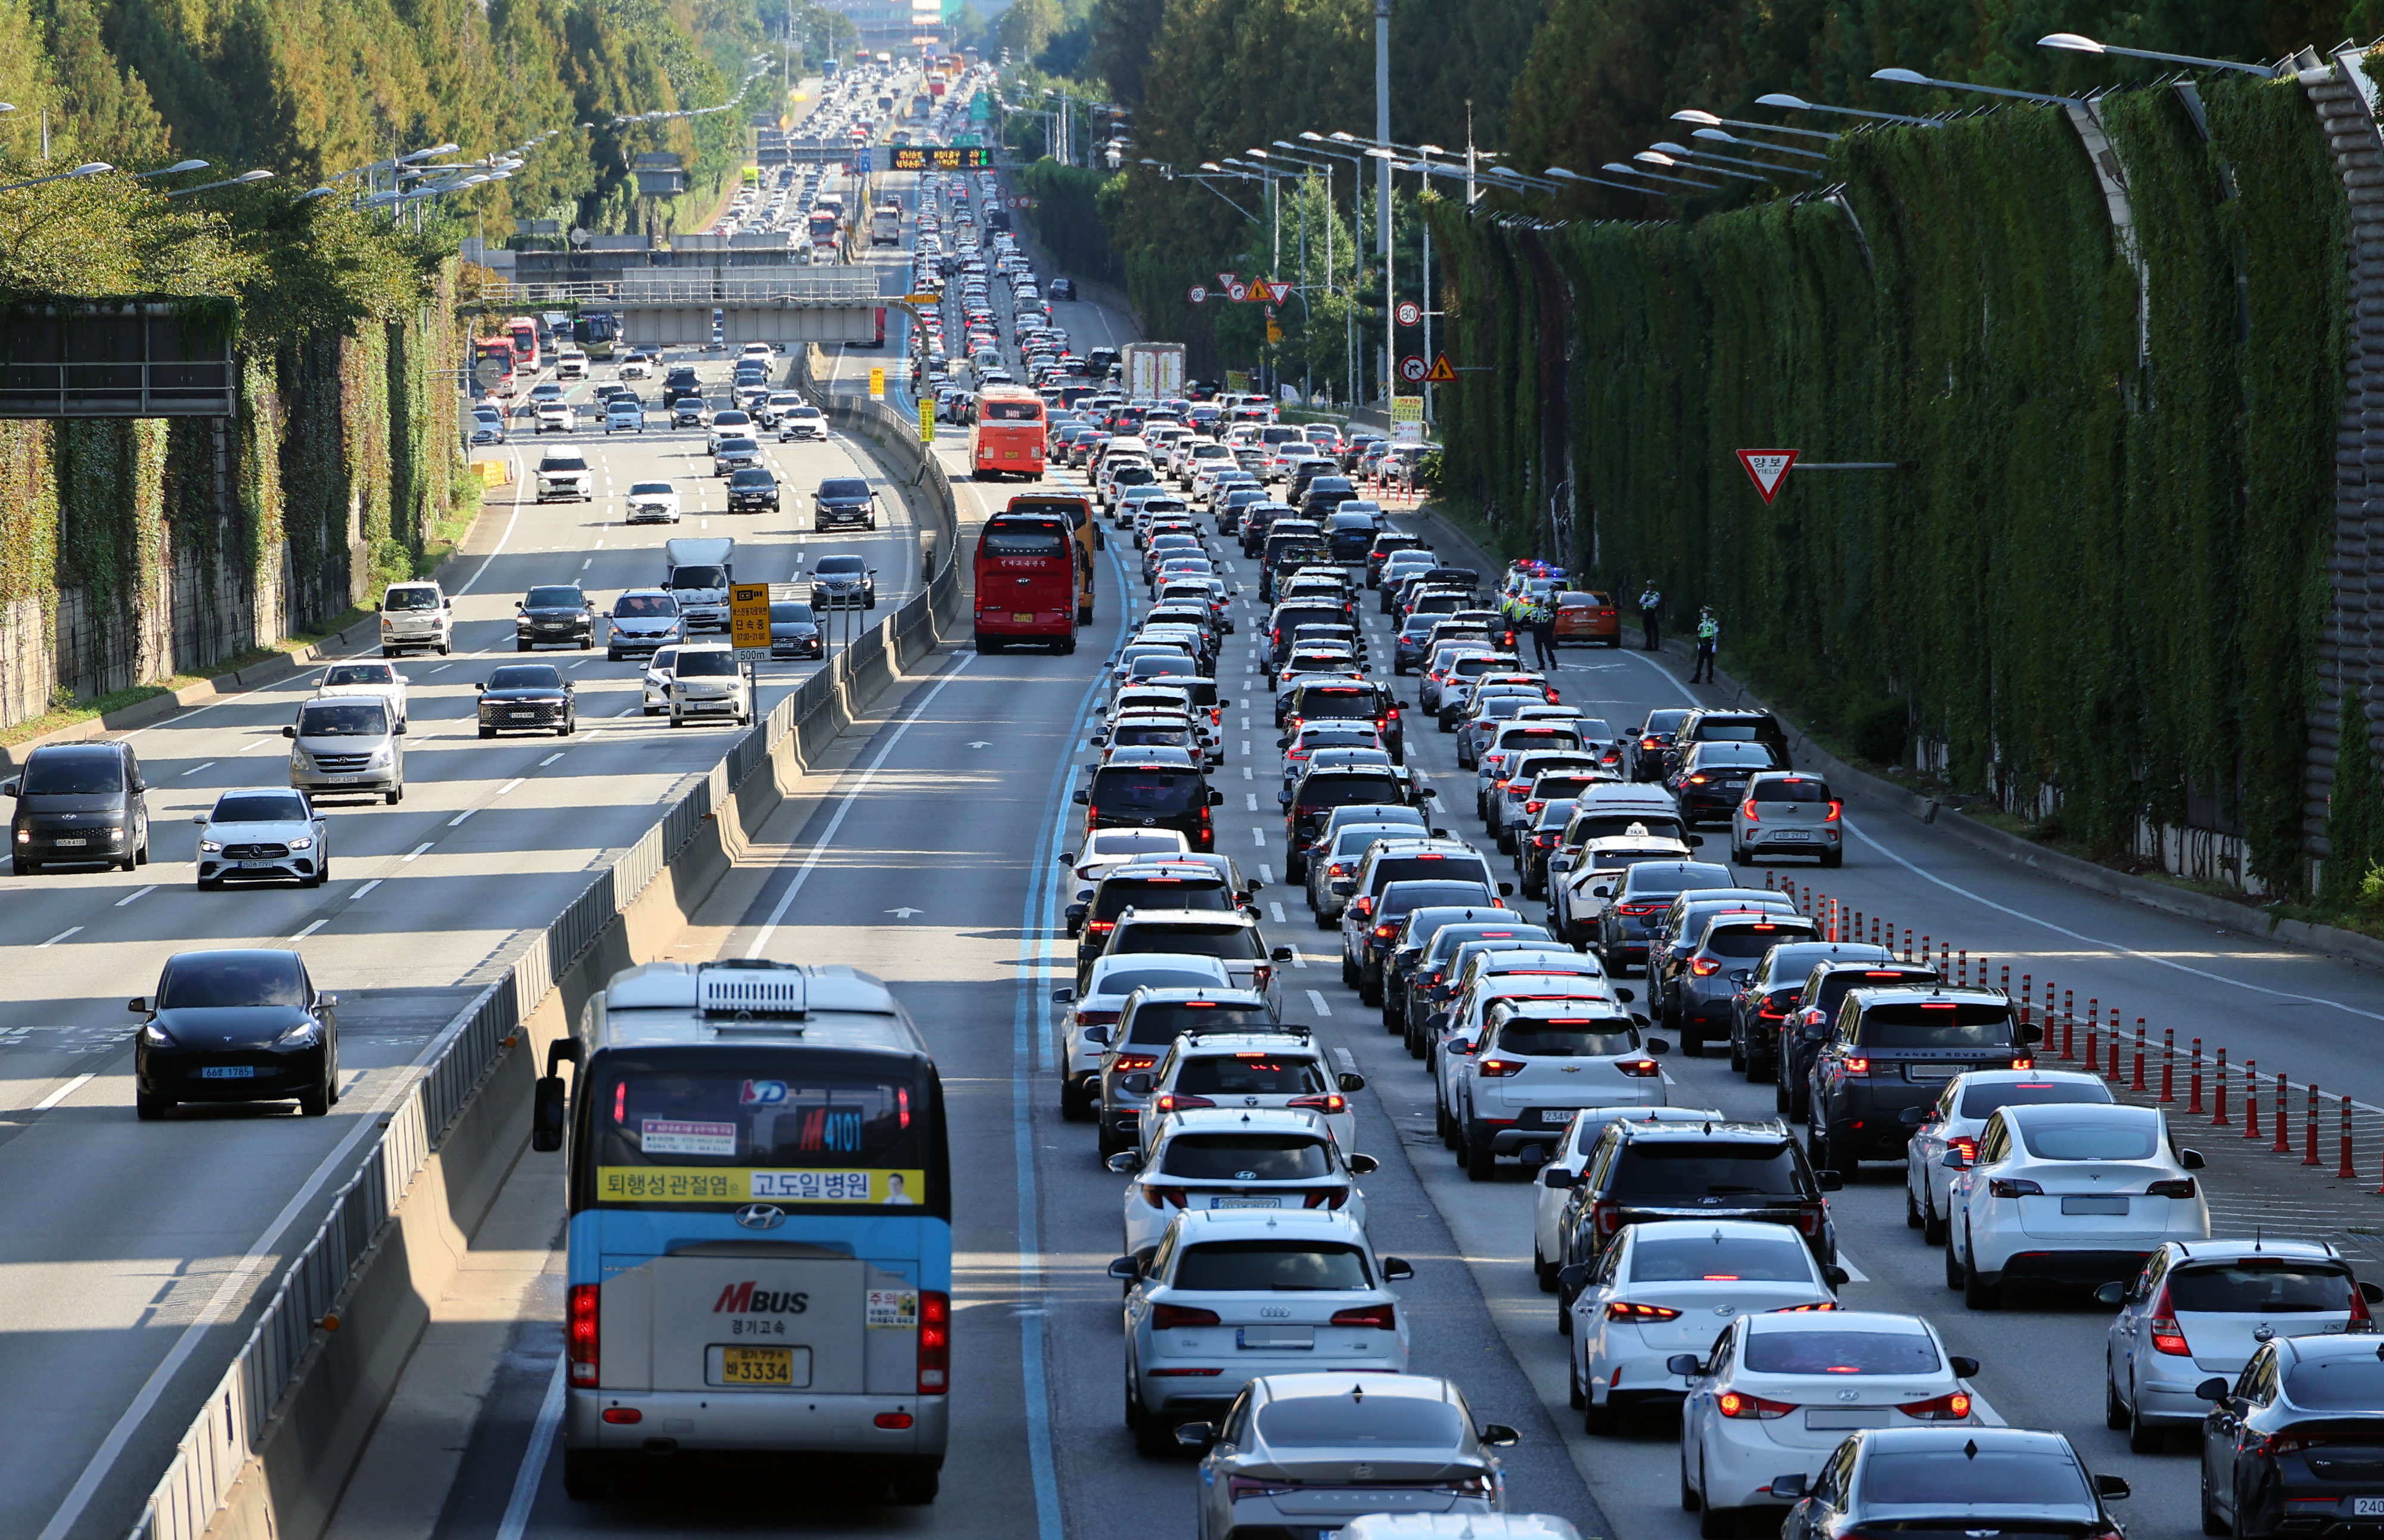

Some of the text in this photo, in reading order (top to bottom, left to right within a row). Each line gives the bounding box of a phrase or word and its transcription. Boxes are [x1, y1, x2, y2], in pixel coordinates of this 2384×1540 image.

[1193, 290, 1204, 299] 80
[1401, 309, 1416, 320] 80
[1005, 409, 1020, 418] 9401
[1754, 457, 1781, 468] 양보
[740, 650, 765, 660] 500m
[228, 1067, 249, 1076] 1785
[732, 1319, 786, 1336] 경기고속
[759, 1350, 775, 1360] 77
[741, 1362, 788, 1380] 3334
[2360, 1499, 2384, 1513] 240
